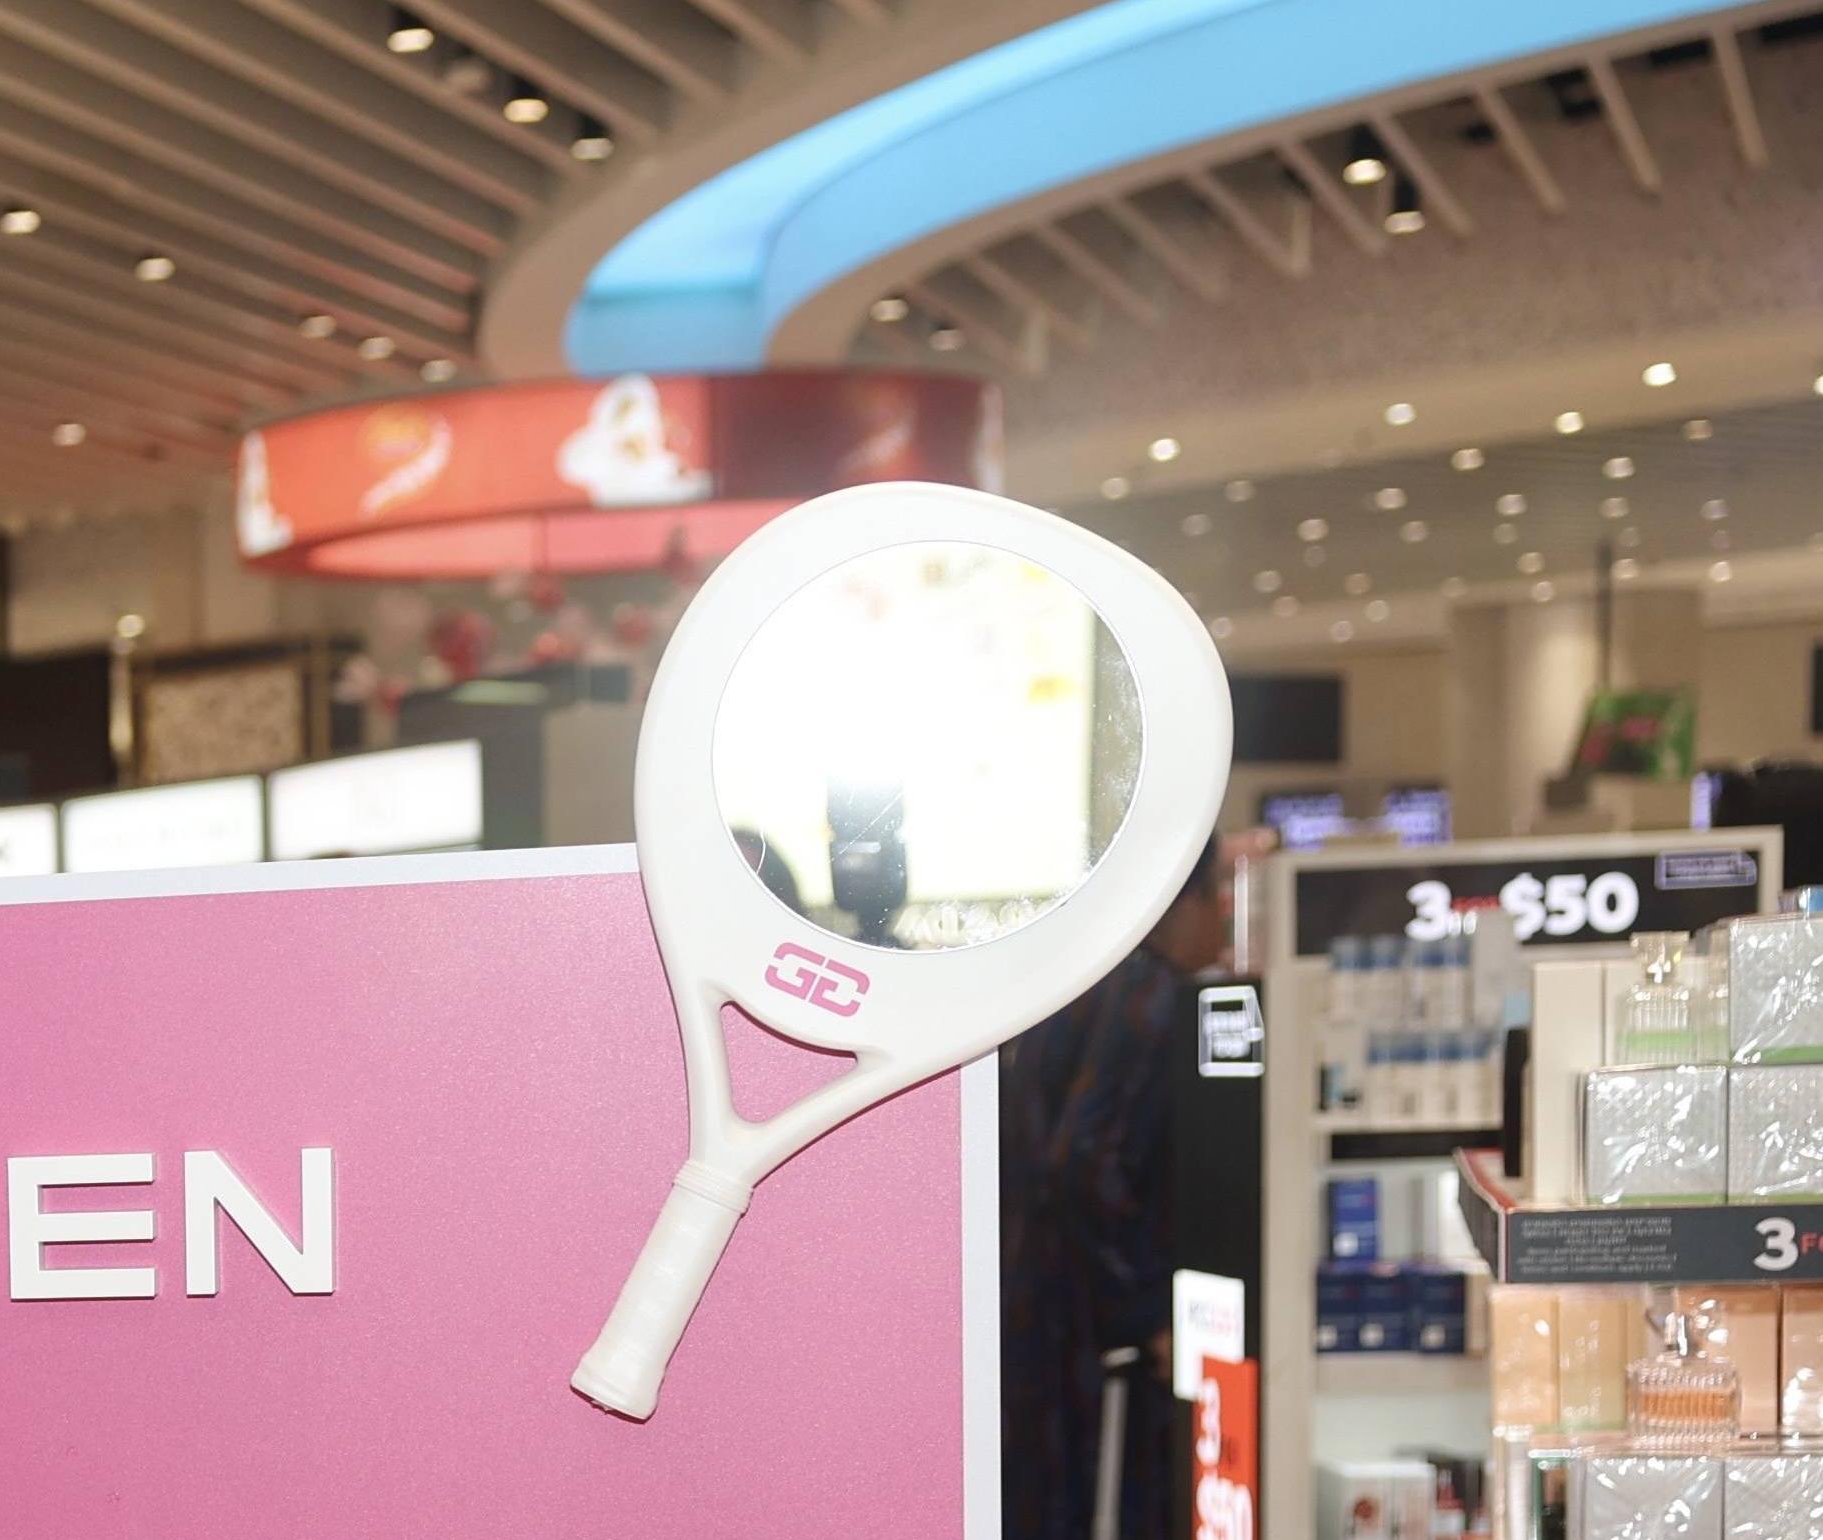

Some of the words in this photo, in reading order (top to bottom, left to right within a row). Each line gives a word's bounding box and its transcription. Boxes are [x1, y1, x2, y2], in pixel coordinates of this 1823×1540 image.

[1405, 879, 1451, 942] 3
[1499, 872, 1639, 942] $50
[1753, 1216, 1800, 1271] 3
